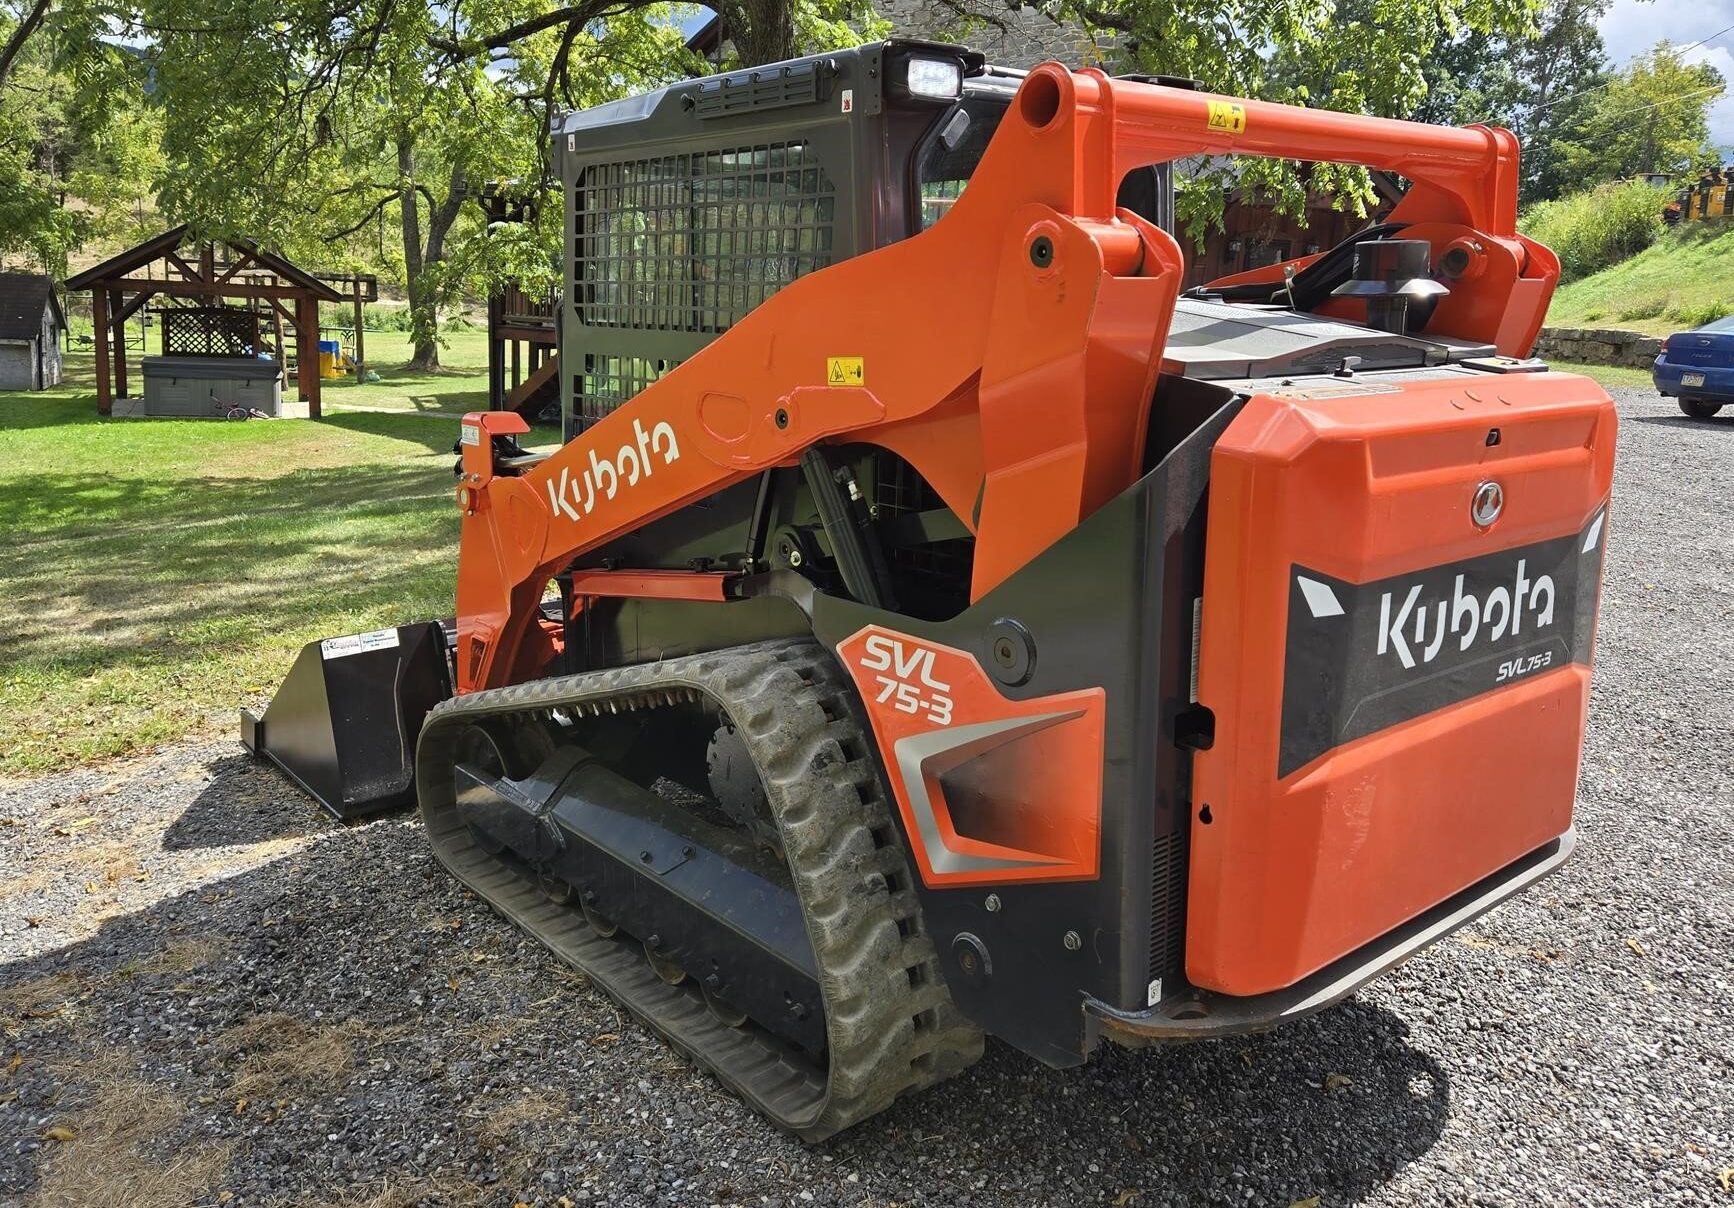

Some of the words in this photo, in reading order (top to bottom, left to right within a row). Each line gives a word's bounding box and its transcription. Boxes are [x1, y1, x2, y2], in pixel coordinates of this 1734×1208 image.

[547, 418, 680, 522] Kubota
[1377, 558, 1555, 669] Kubota
[861, 635, 950, 693] SVL
[876, 675, 953, 725] 75-3
